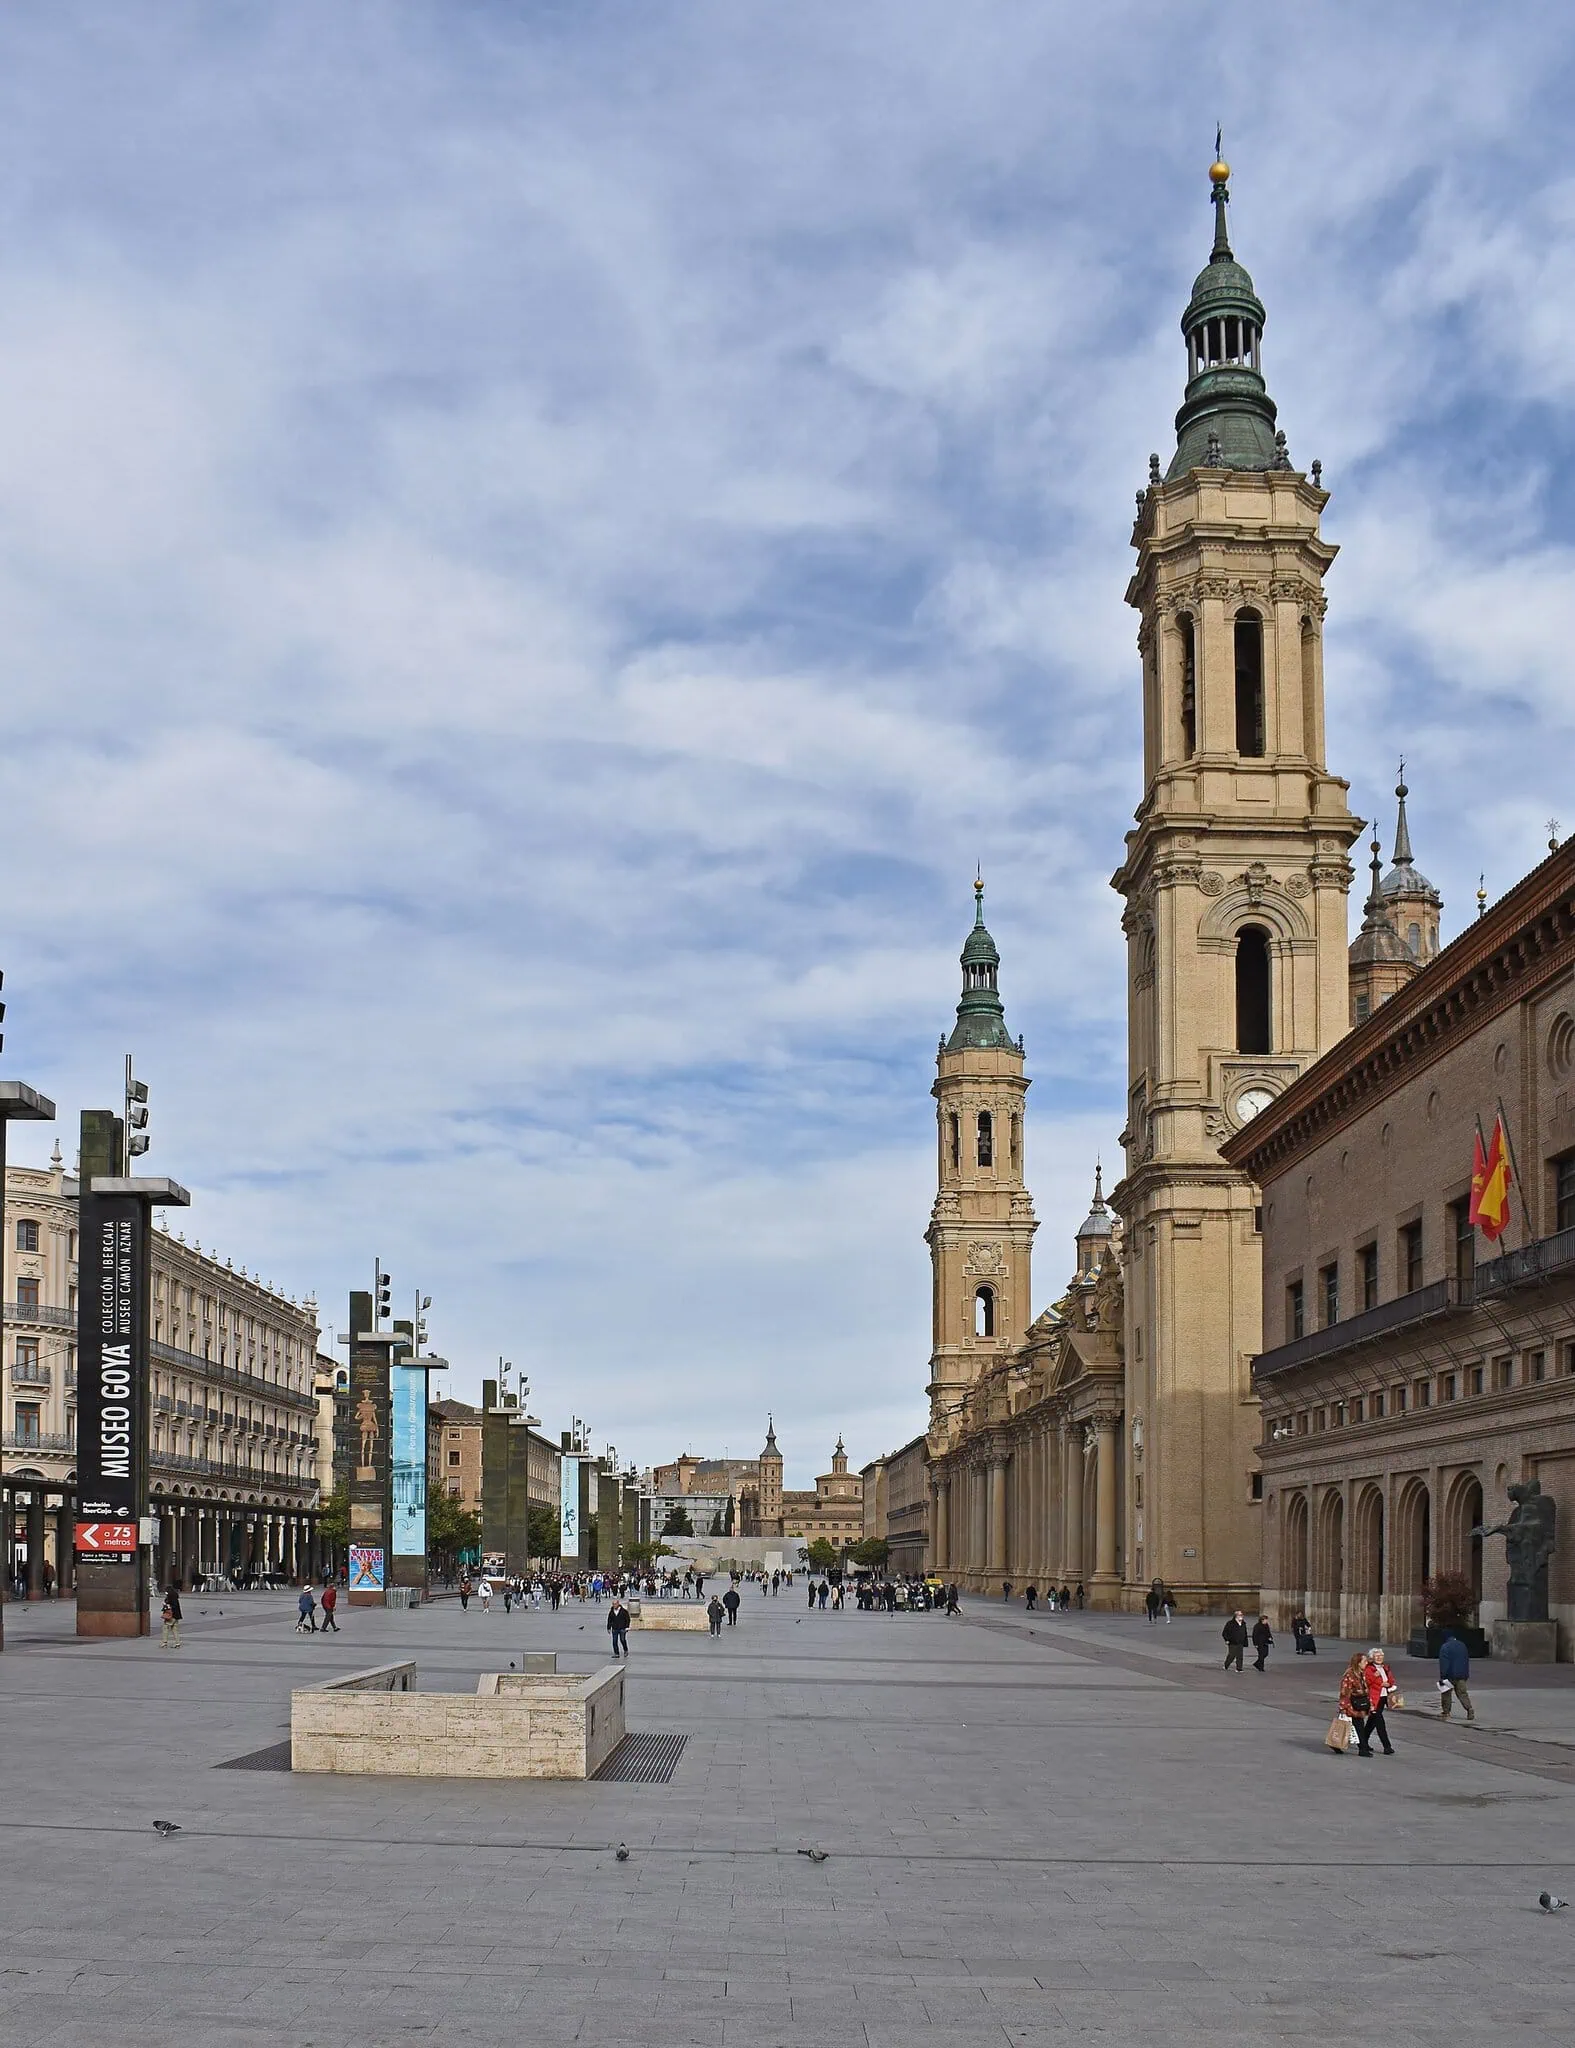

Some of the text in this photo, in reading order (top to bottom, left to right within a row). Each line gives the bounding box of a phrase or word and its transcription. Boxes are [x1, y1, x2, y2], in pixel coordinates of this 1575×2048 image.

[100, 1221, 114, 1334] COLECCIÓN IBERCAJA
[118, 1221, 132, 1334] MUSEO CAMÓN AZNAR
[100, 1344, 131, 1478] MUSEO GOYA
[113, 1526, 131, 1538] 75
